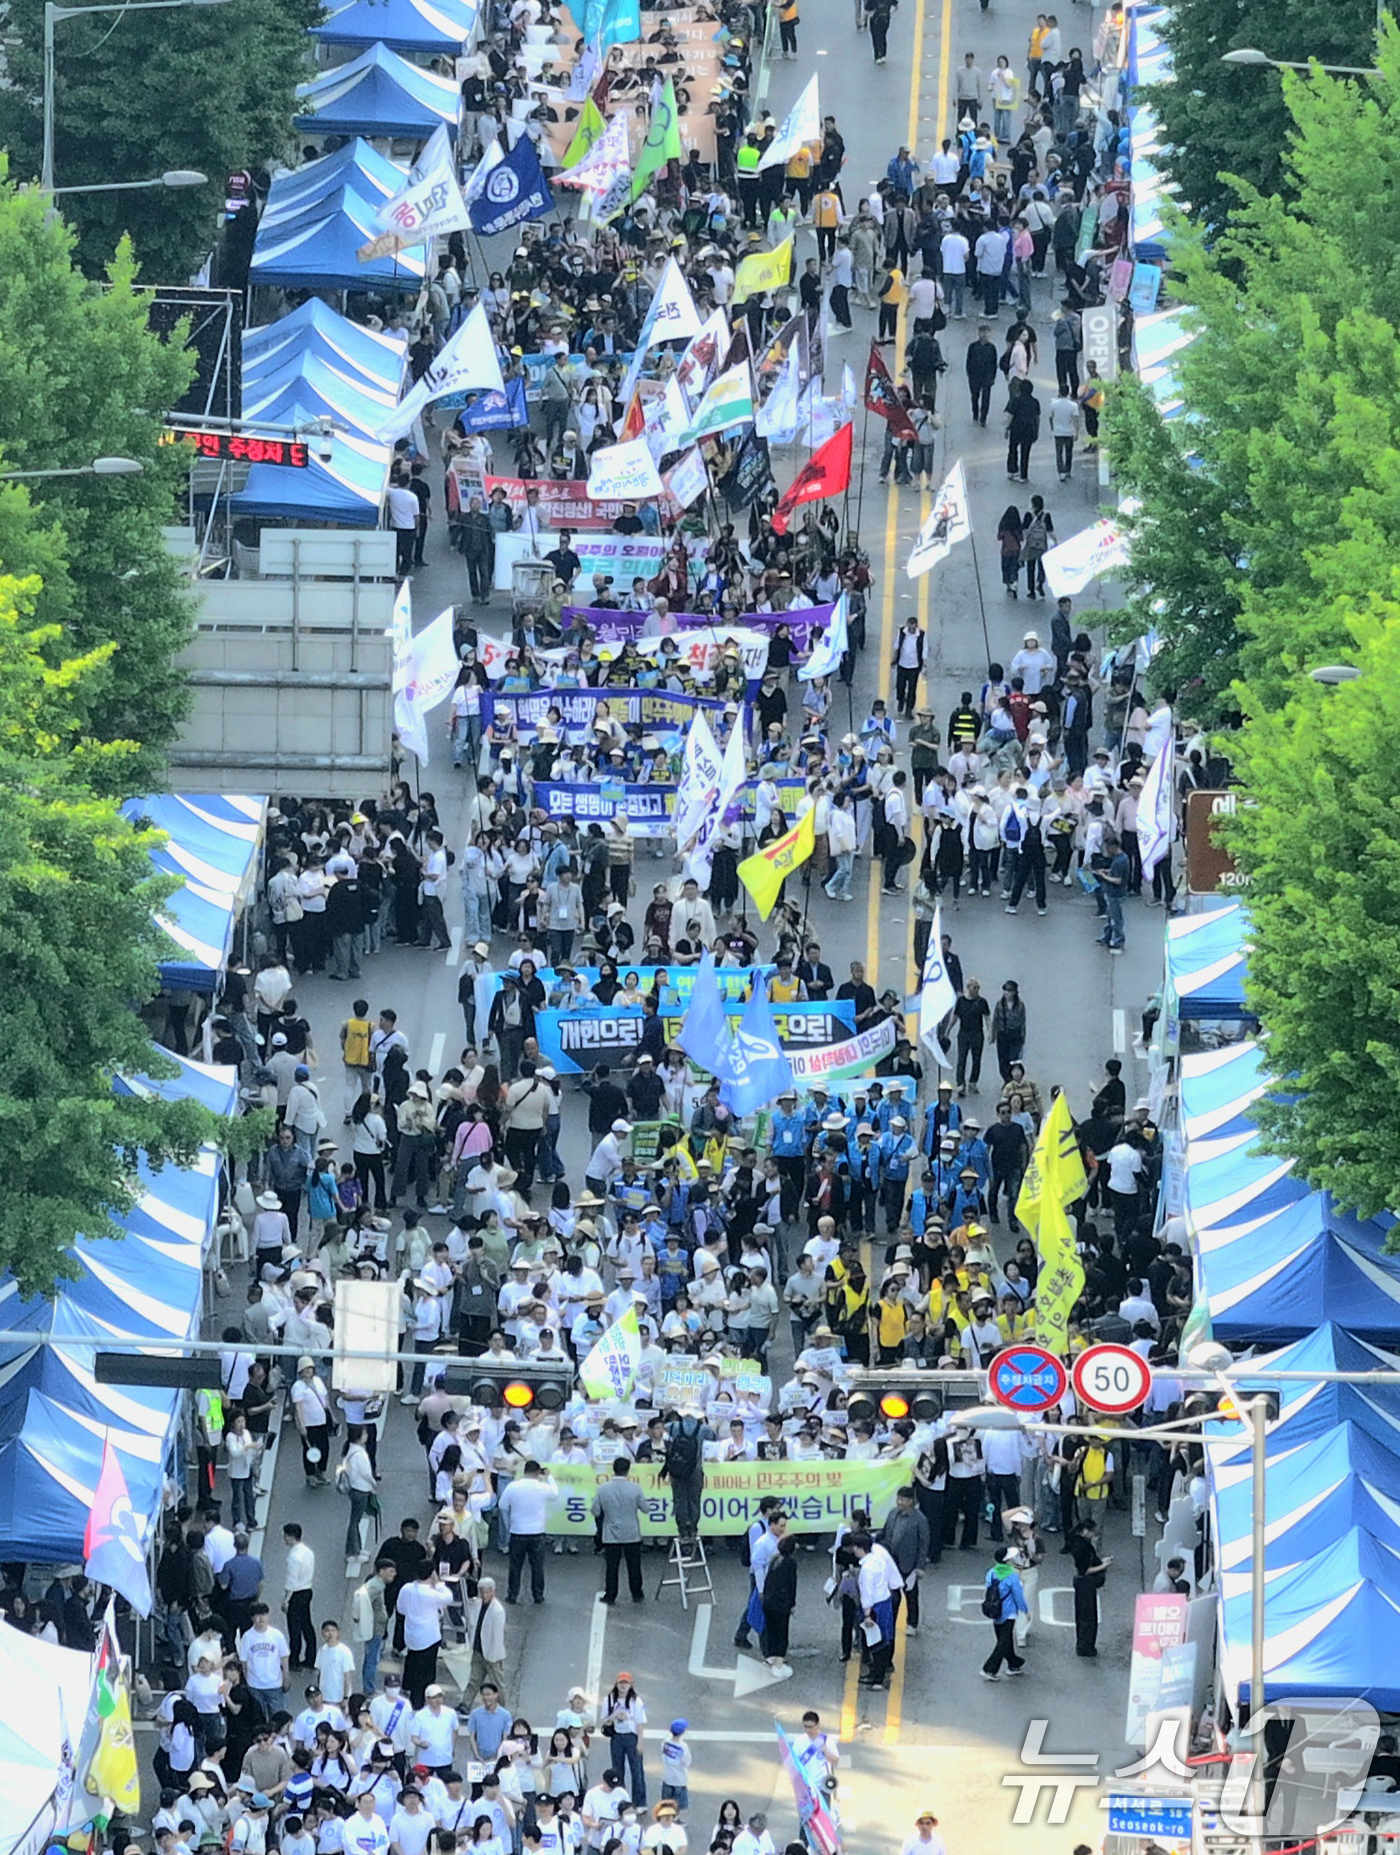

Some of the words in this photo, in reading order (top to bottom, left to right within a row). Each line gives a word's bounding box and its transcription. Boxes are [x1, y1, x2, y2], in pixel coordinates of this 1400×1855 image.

[549, 790, 573, 814] 모든
[575, 793, 613, 816] 생명이
[558, 1018, 643, 1050] 개헌으로!
[1000, 1374, 1054, 1386] 주정차금지
[1094, 1366, 1130, 1392] 50
[756, 1472, 821, 1490] 민주주의
[1112, 1795, 1165, 1818] 서석로
[1112, 1817, 1185, 1835] Seoseok-ro
